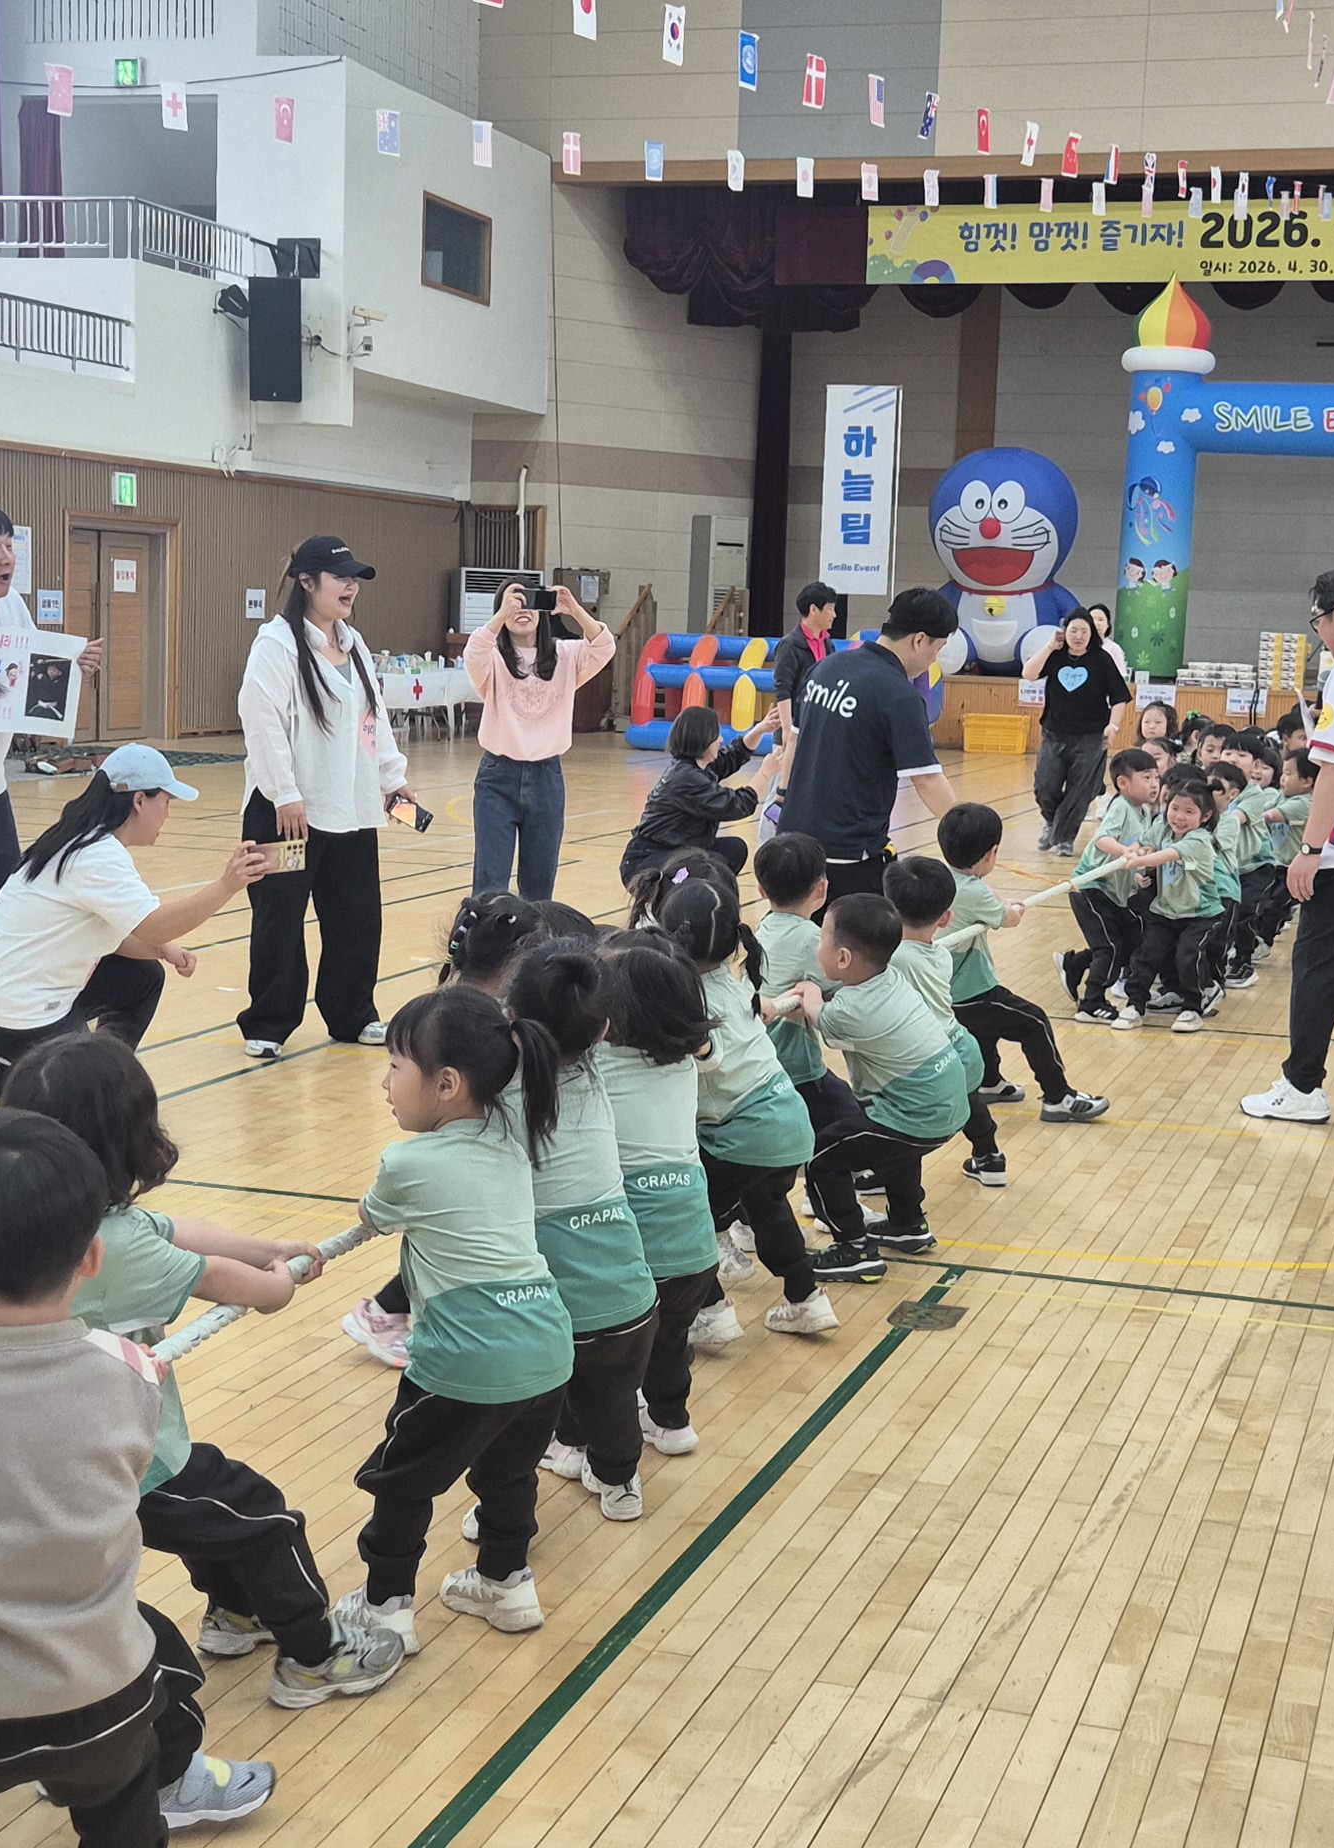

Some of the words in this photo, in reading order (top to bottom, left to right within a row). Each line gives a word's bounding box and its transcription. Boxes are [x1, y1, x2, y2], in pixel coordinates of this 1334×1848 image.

[958, 221, 1018, 253] 힘껏!
[1028, 220, 1088, 252] 맘껏!
[1099, 219, 1184, 251] 즐기자!
[1199, 211, 1321, 250] 2026.
[1199, 260, 1233, 276] 일시:
[1237, 260, 1281, 274] 2026.
[1287, 260, 1303, 274] 4.
[1309, 259, 1334, 274] 30.
[1213, 402, 1314, 433] SMILE
[840, 425, 878, 545] 하늘팀
[827, 563, 853, 572] Smile
[853, 563, 881, 573] Event
[803, 679, 858, 718] smile
[636, 1172, 691, 1189] CRAPAS
[569, 1206, 626, 1230] CRAPAS
